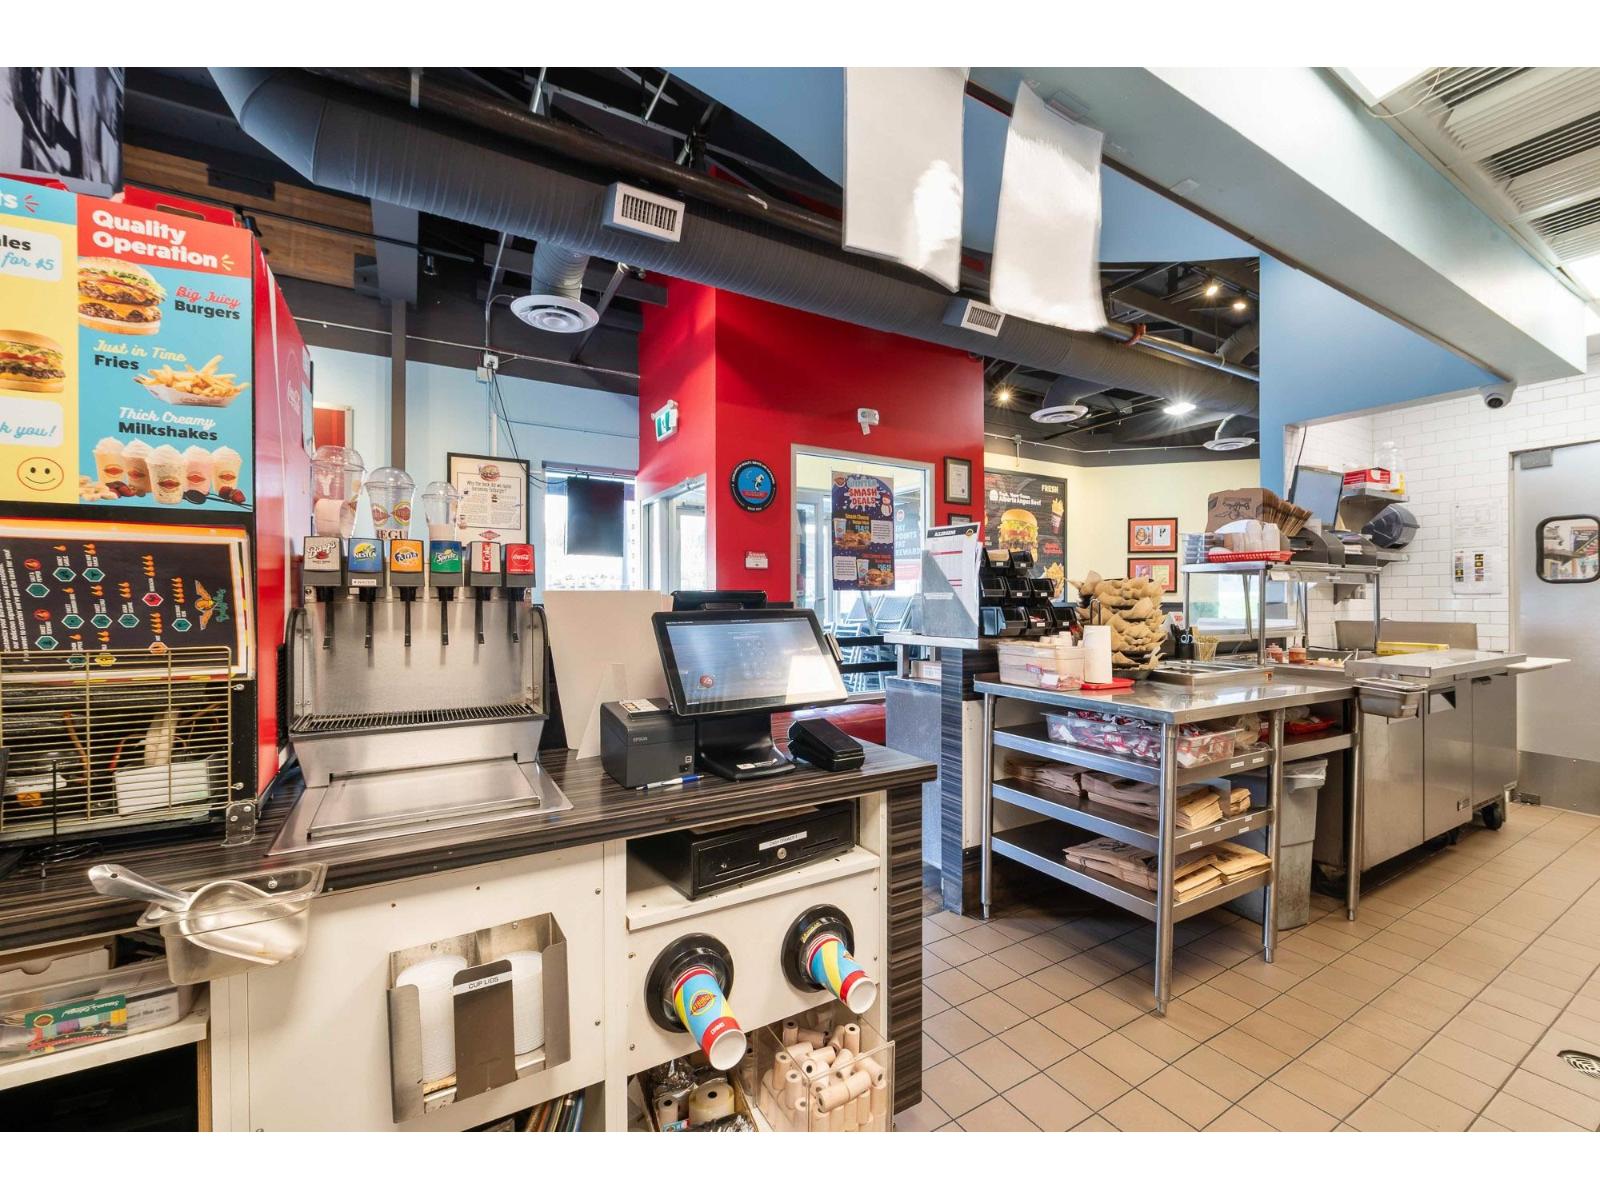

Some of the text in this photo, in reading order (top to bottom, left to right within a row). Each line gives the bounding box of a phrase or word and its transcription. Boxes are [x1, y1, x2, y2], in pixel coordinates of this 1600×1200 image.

[92, 210, 187, 244] Quality
[92, 230, 218, 269] Operation
[1, 251, 55, 271] for $5
[175, 285, 241, 310] Big Juicy
[174, 299, 241, 321] Burgers
[92, 339, 187, 363] Just in Time
[94, 354, 140, 371] Fries
[118, 406, 216, 429] Thick Creamy
[12, 424, 56, 438] you!
[118, 421, 218, 441] Milkshakes
[848, 488, 877, 497] SMASH
[1041, 484, 1059, 493] FRESH
[395, 551, 418, 562] Fanta
[468, 975, 499, 990] CUP LIDS
